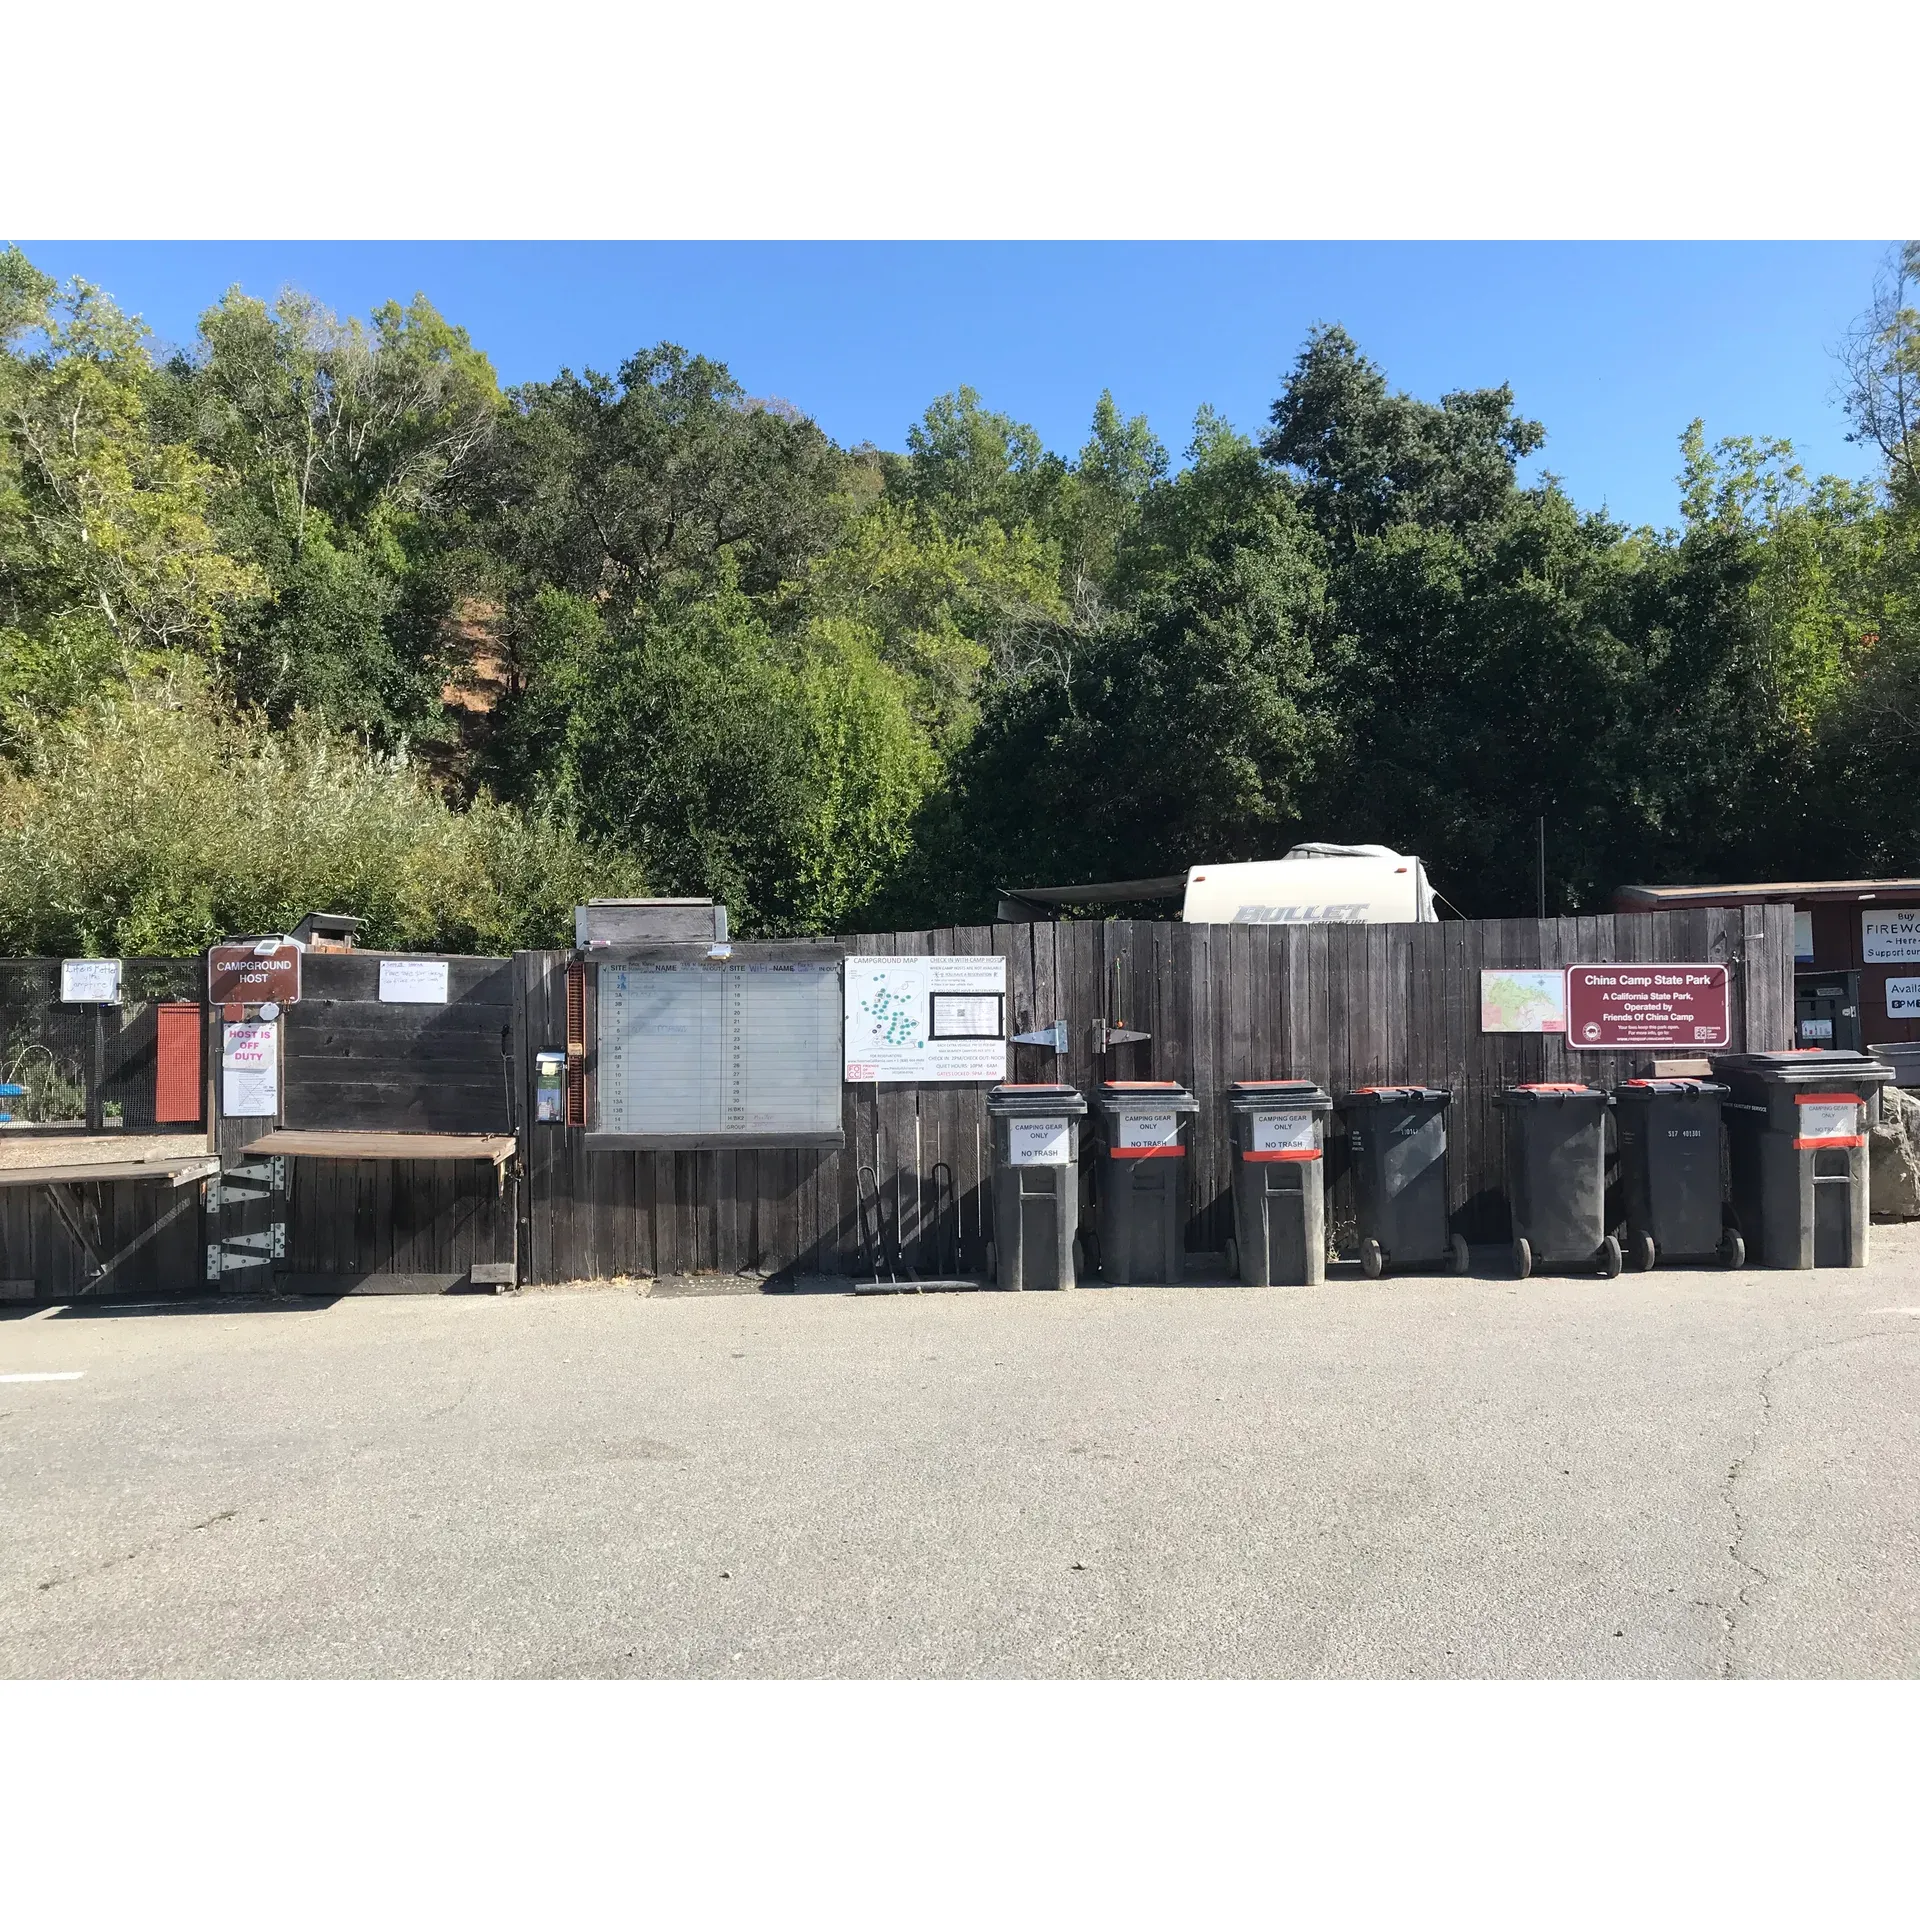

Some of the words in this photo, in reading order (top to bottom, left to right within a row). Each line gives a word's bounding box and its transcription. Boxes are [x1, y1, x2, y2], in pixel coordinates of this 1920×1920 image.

[1233, 904, 1370, 922] BULLET
[1898, 913, 1914, 921] Buy
[1868, 948, 1904, 957] Support
[216, 960, 291, 971] CAMPGROUND
[239, 974, 268, 983] HOST
[1585, 975, 1616, 985] China
[1620, 976, 1652, 986] Camp
[1655, 975, 1683, 985] State
[1686, 975, 1710, 984] Park
[1673, 993, 1693, 1001] Park,
[1624, 1003, 1661, 1011] Operated
[1663, 1003, 1672, 1011] by
[1670, 1014, 1694, 1022] Camp
